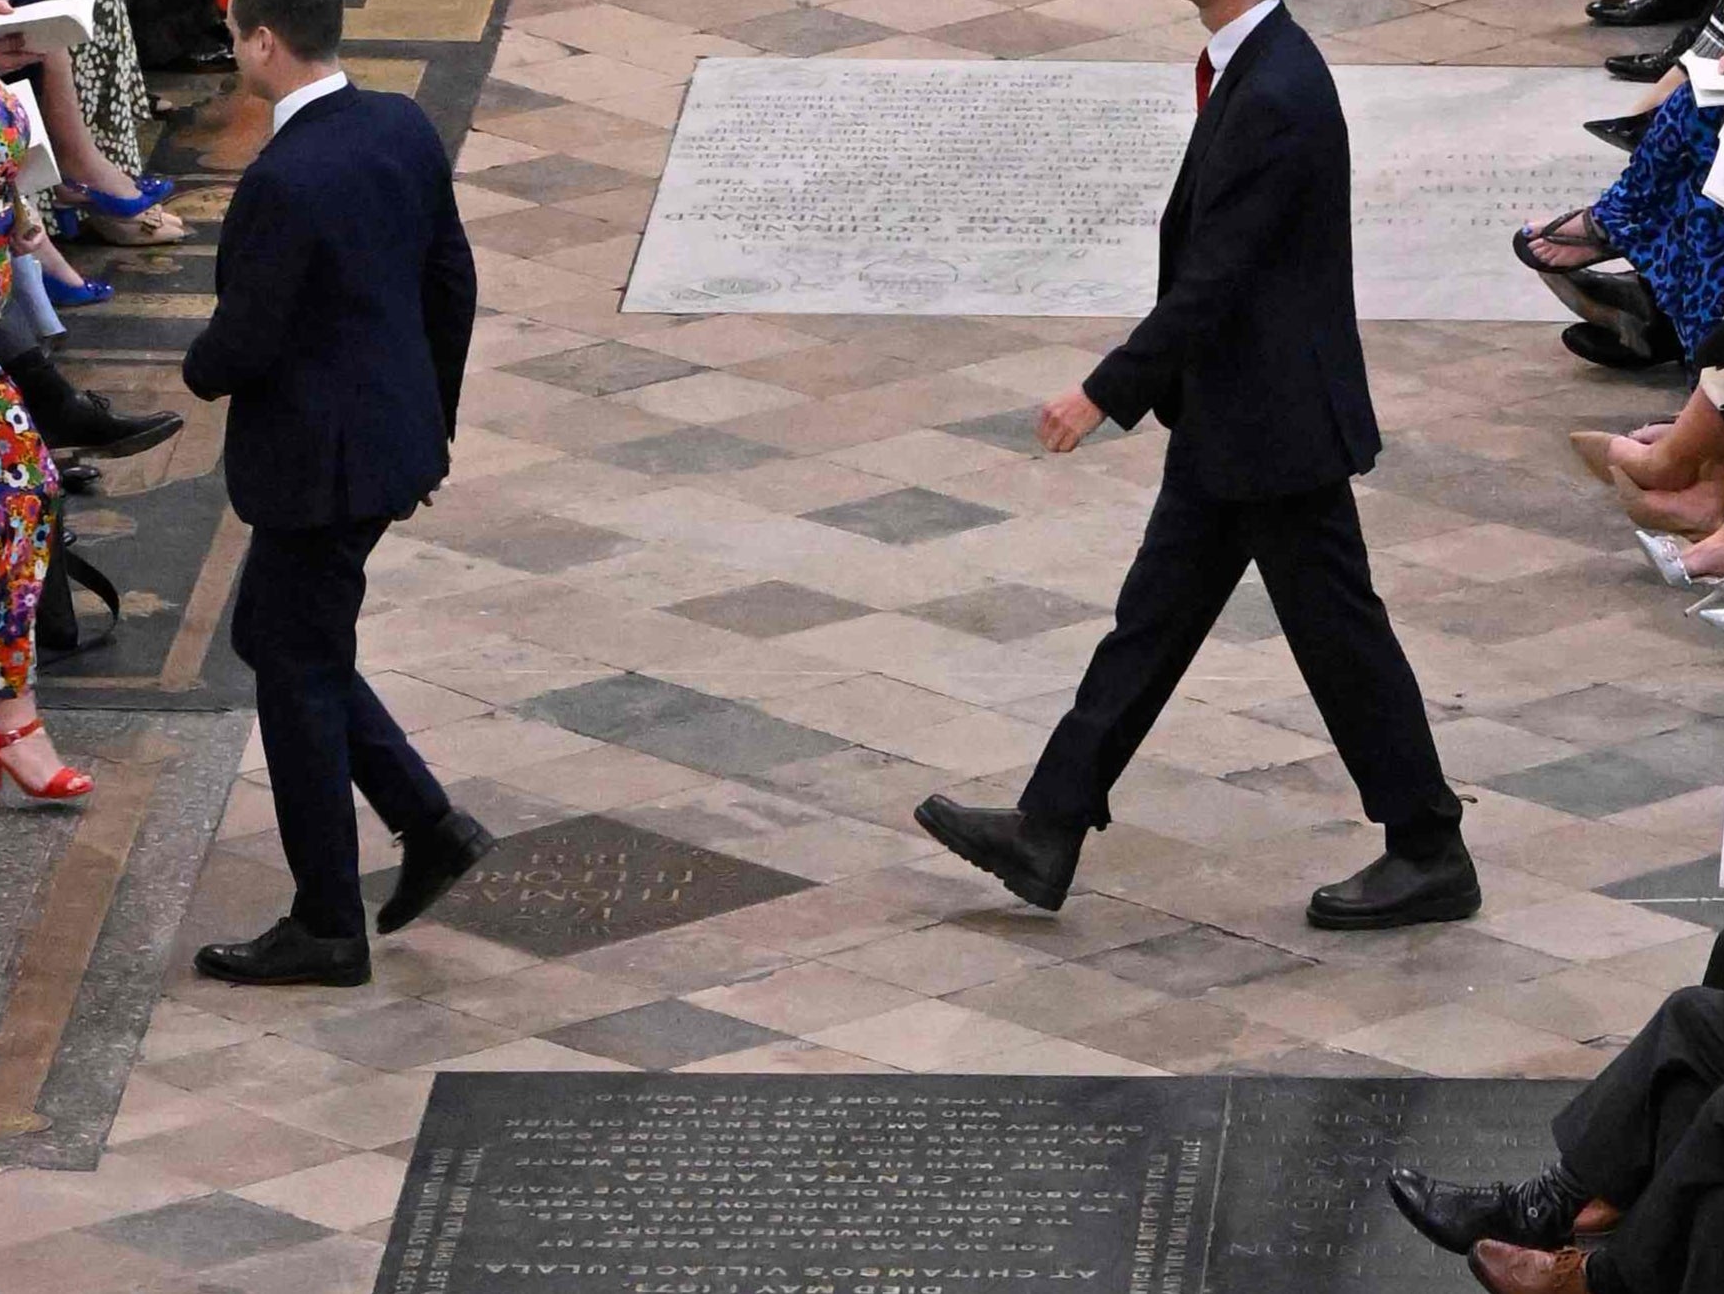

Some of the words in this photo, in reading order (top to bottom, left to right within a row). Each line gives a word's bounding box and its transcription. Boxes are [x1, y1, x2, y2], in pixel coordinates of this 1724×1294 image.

[664, 212, 880, 223] DUNDONALD
[898, 215, 942, 224] OF
[741, 223, 930, 234] COCHRANE
[956, 226, 1099, 236] THOMAS
[773, 1172, 955, 1184] CENTRAL
[966, 1174, 1004, 1184] OF
[803, 1266, 1036, 1279] CHITAMBO'S
[1050, 1268, 1098, 1279] AT
[755, 1284, 835, 1294] MAY
[853, 1284, 942, 1294] DIED
